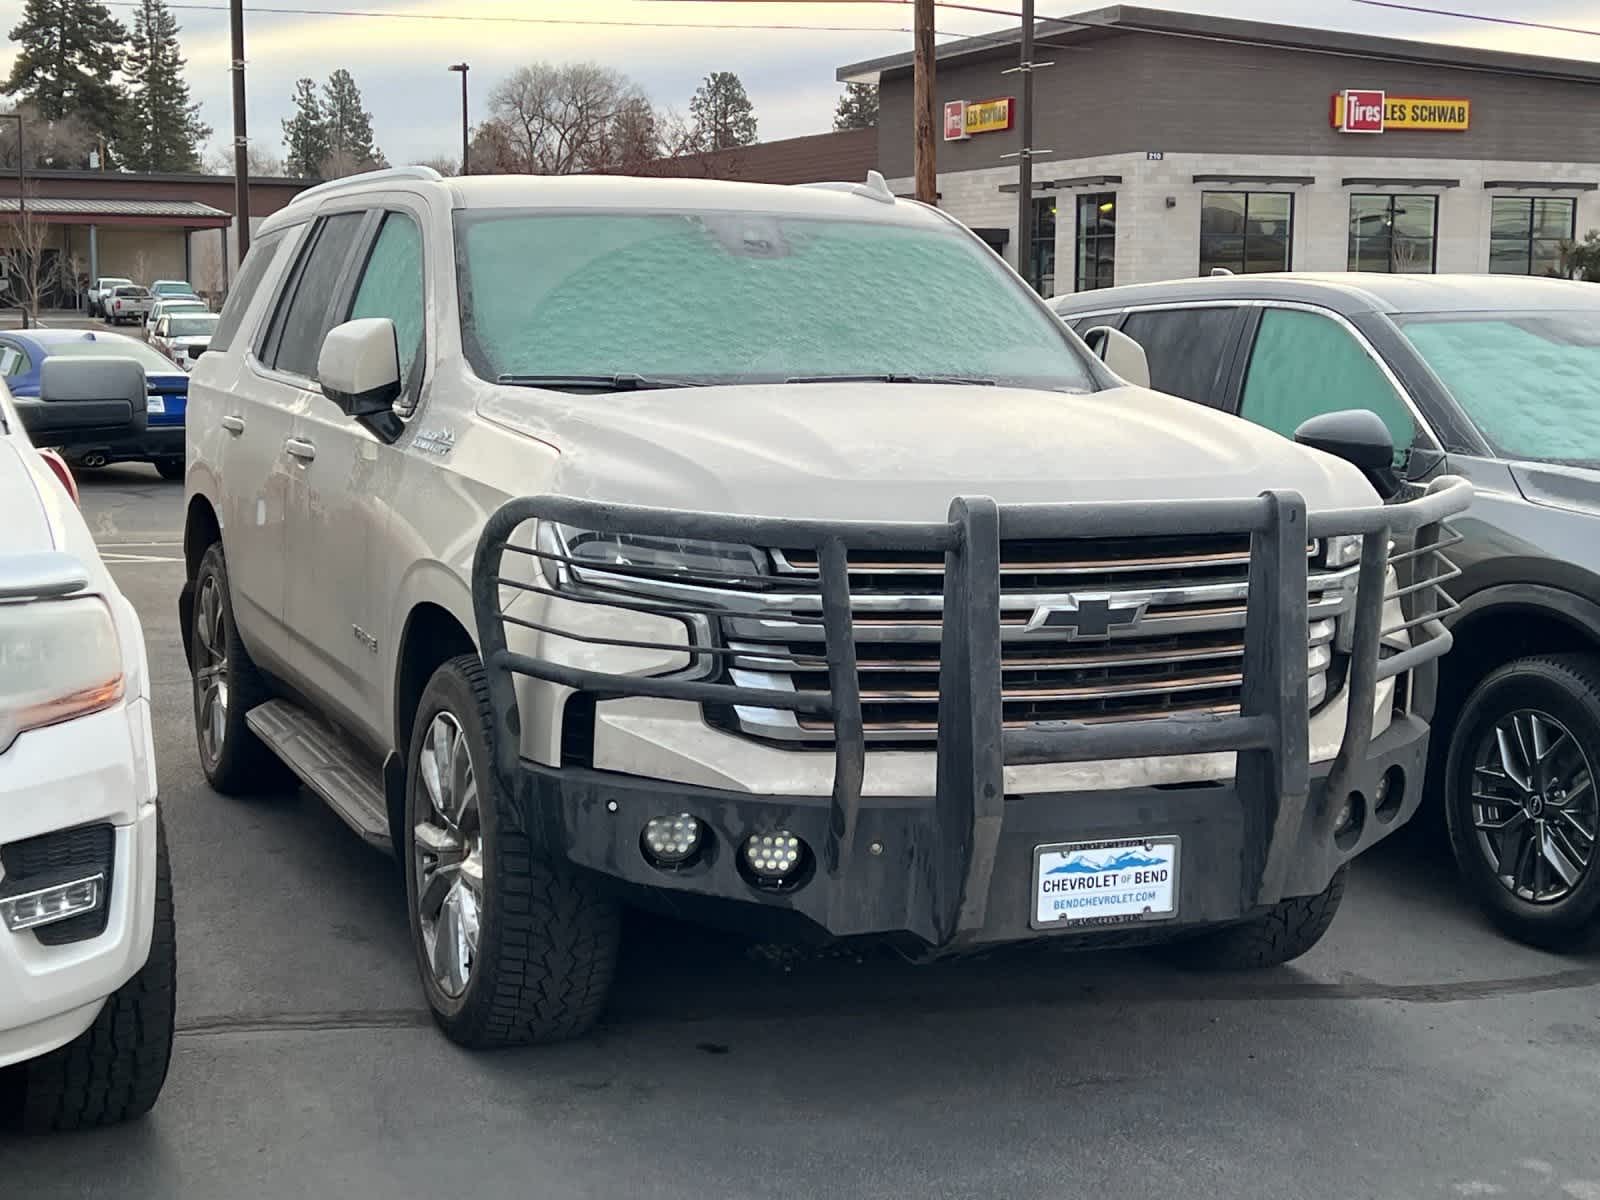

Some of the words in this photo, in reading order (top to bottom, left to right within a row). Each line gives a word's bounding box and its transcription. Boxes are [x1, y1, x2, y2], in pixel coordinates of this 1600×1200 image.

[1348, 96, 1381, 127] Tires
[1383, 104, 1406, 121] LES
[1411, 104, 1465, 123] SCHWAB
[1149, 152, 1162, 160] 210
[1043, 874, 1119, 893] CHEVROLET
[1121, 874, 1132, 884] OF
[1134, 869, 1168, 884] BEND
[1054, 891, 1156, 910] BENDCHEVROLET.COM
